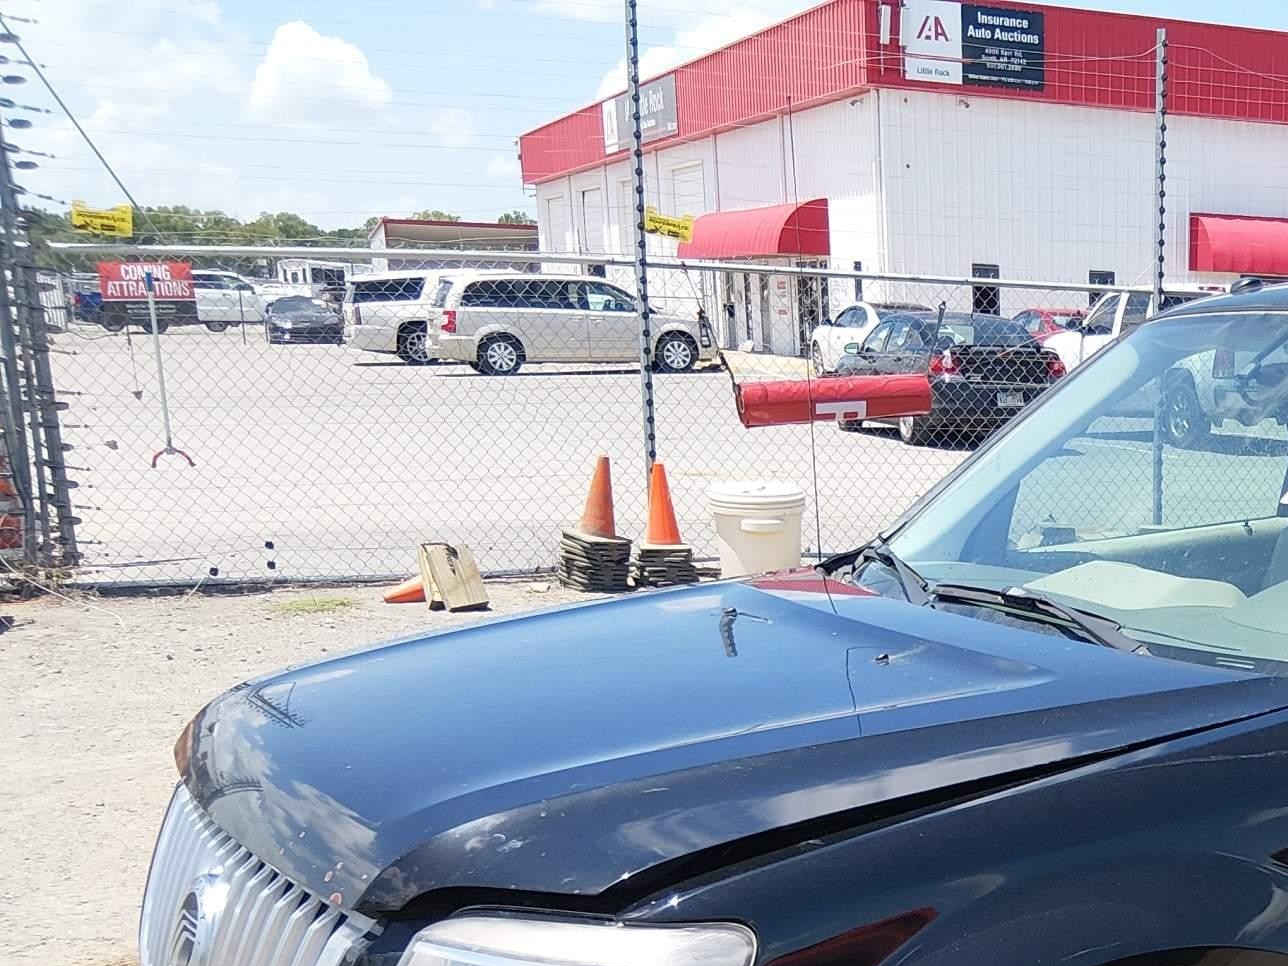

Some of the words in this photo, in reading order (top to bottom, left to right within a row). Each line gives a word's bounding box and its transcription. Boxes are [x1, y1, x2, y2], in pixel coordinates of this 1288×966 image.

[977, 11, 1029, 29] Insurance
[967, 25, 992, 40] Auto
[994, 26, 1039, 45] Auctions
[917, 66, 933, 75] Little
[934, 68, 951, 77] Rock
[649, 86, 664, 114] Rock
[107, 281, 190, 297] ATTRATIONS
